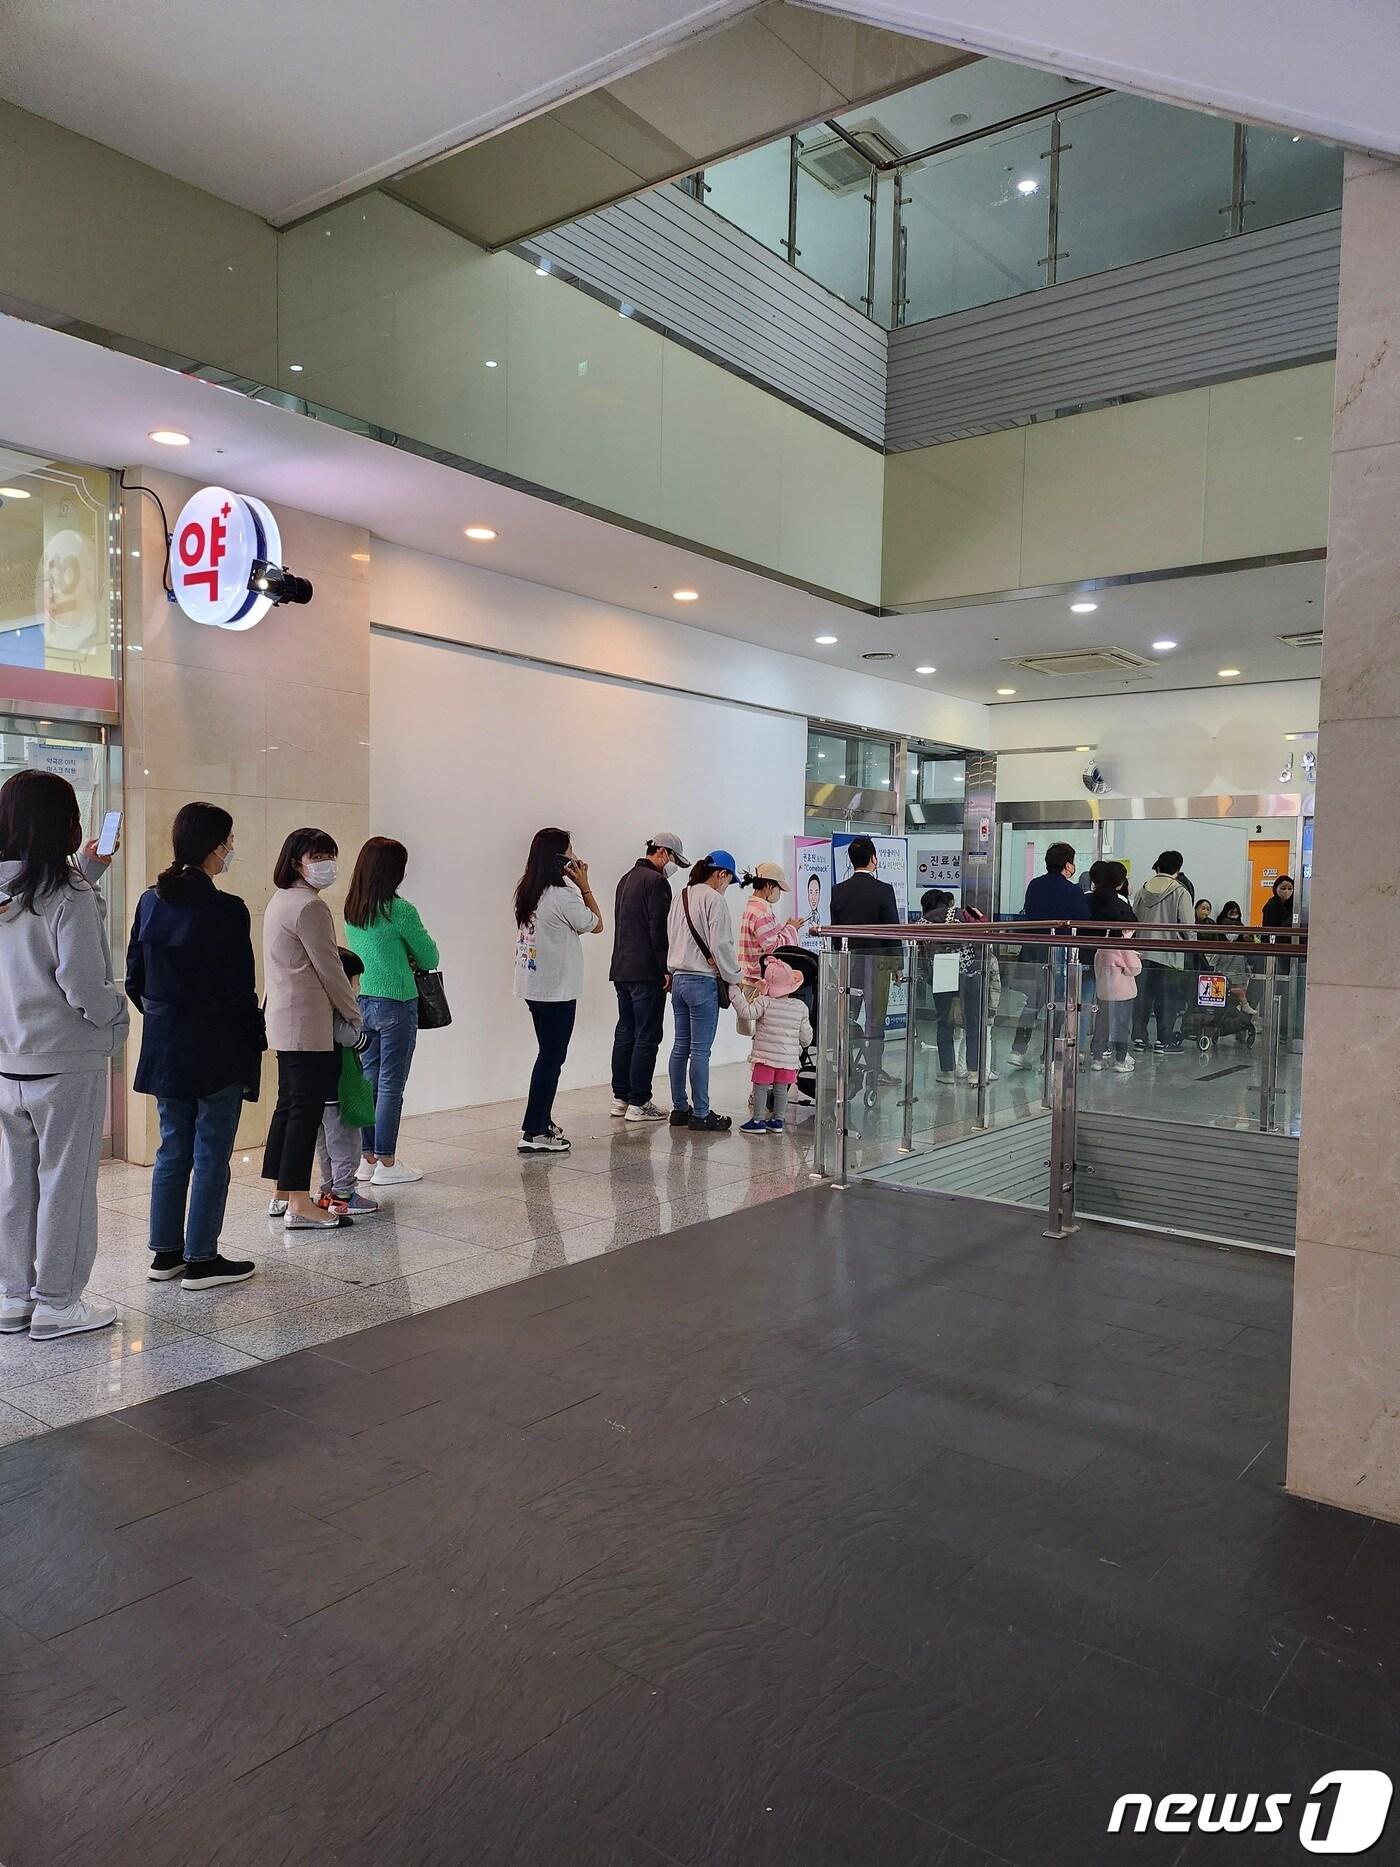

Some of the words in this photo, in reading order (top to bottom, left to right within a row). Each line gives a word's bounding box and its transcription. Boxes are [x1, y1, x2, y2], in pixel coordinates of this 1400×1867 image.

[179, 516, 226, 602] 약
[1256, 825, 1262, 833] 2
[930, 855, 960, 867] 진료실
